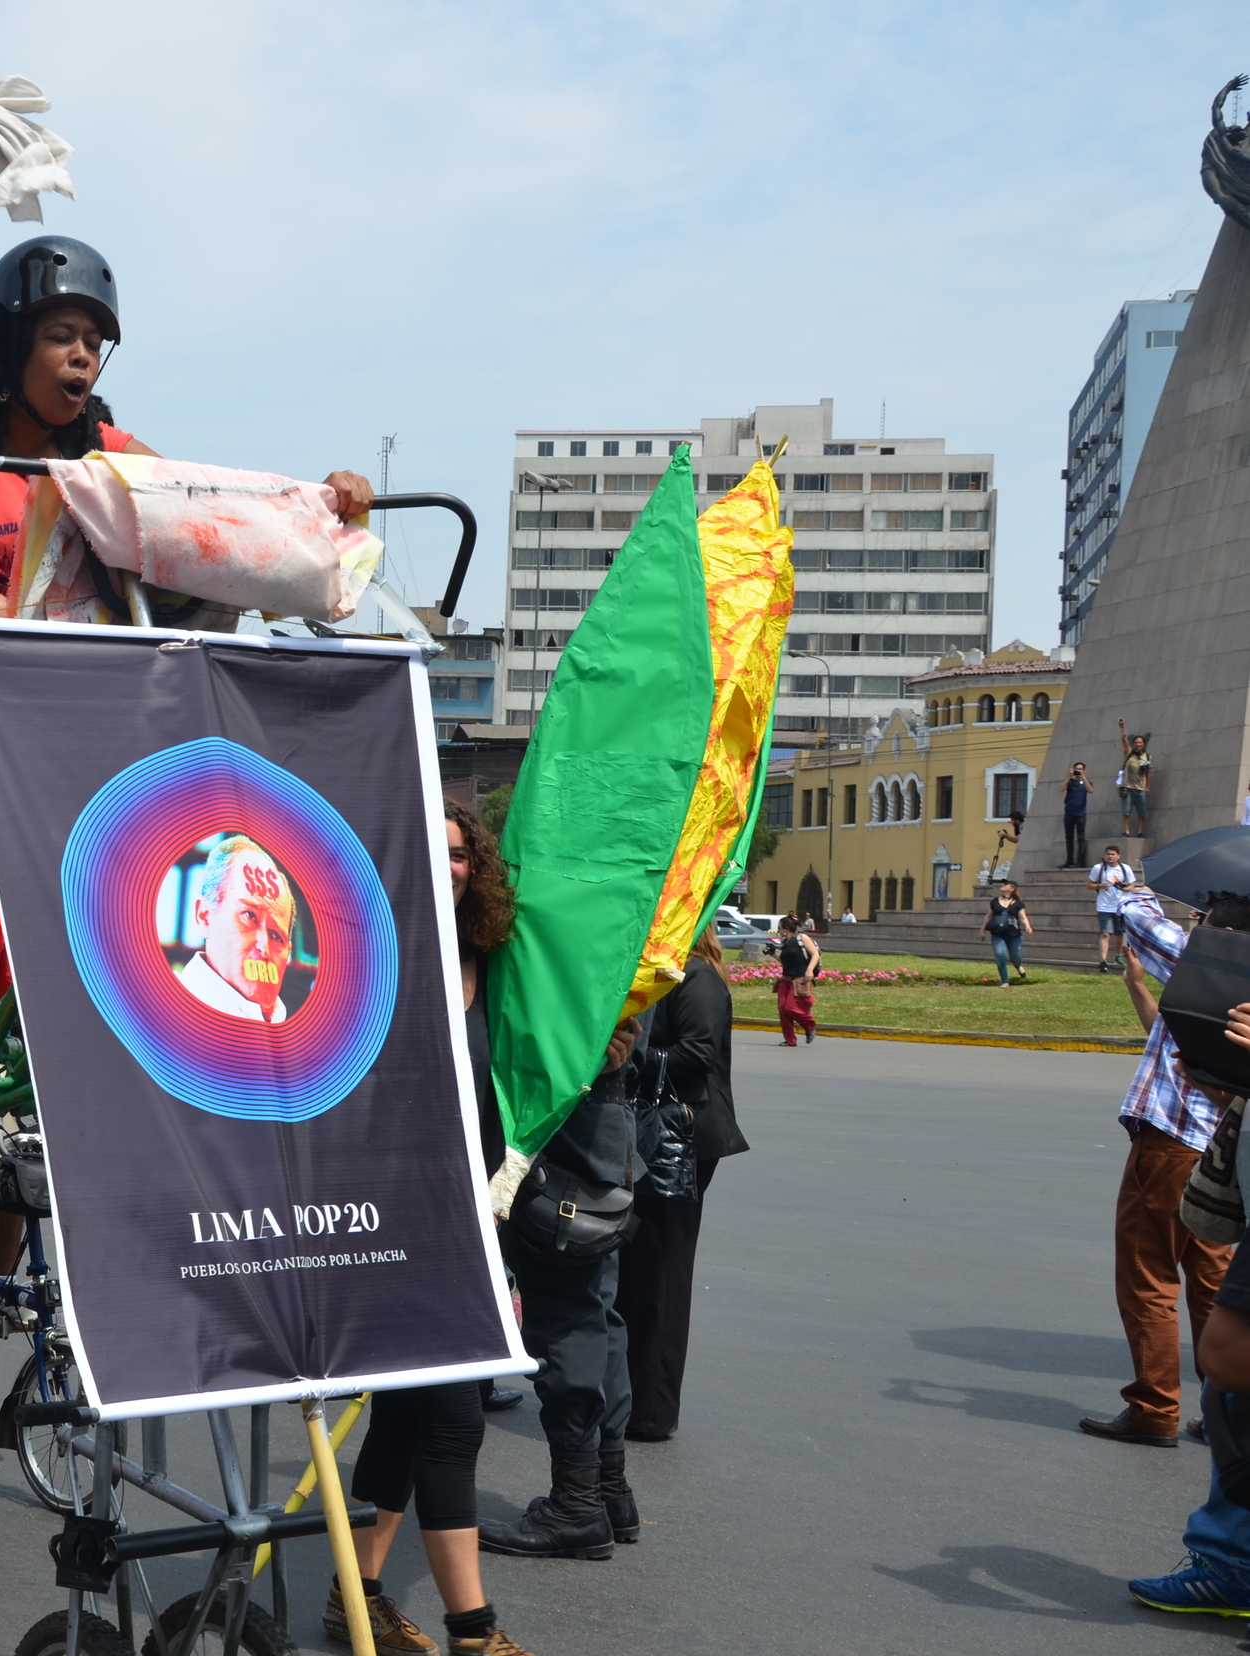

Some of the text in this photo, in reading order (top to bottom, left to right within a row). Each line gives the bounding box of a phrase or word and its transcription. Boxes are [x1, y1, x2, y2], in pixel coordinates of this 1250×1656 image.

[243, 958, 279, 985] ORO
[188, 1207, 286, 1244] LIMA
[180, 1262, 241, 1279] PUEBLOS
[329, 1254, 353, 1267] POR
[353, 1252, 369, 1265] LA
[371, 1249, 408, 1263] PACHA
